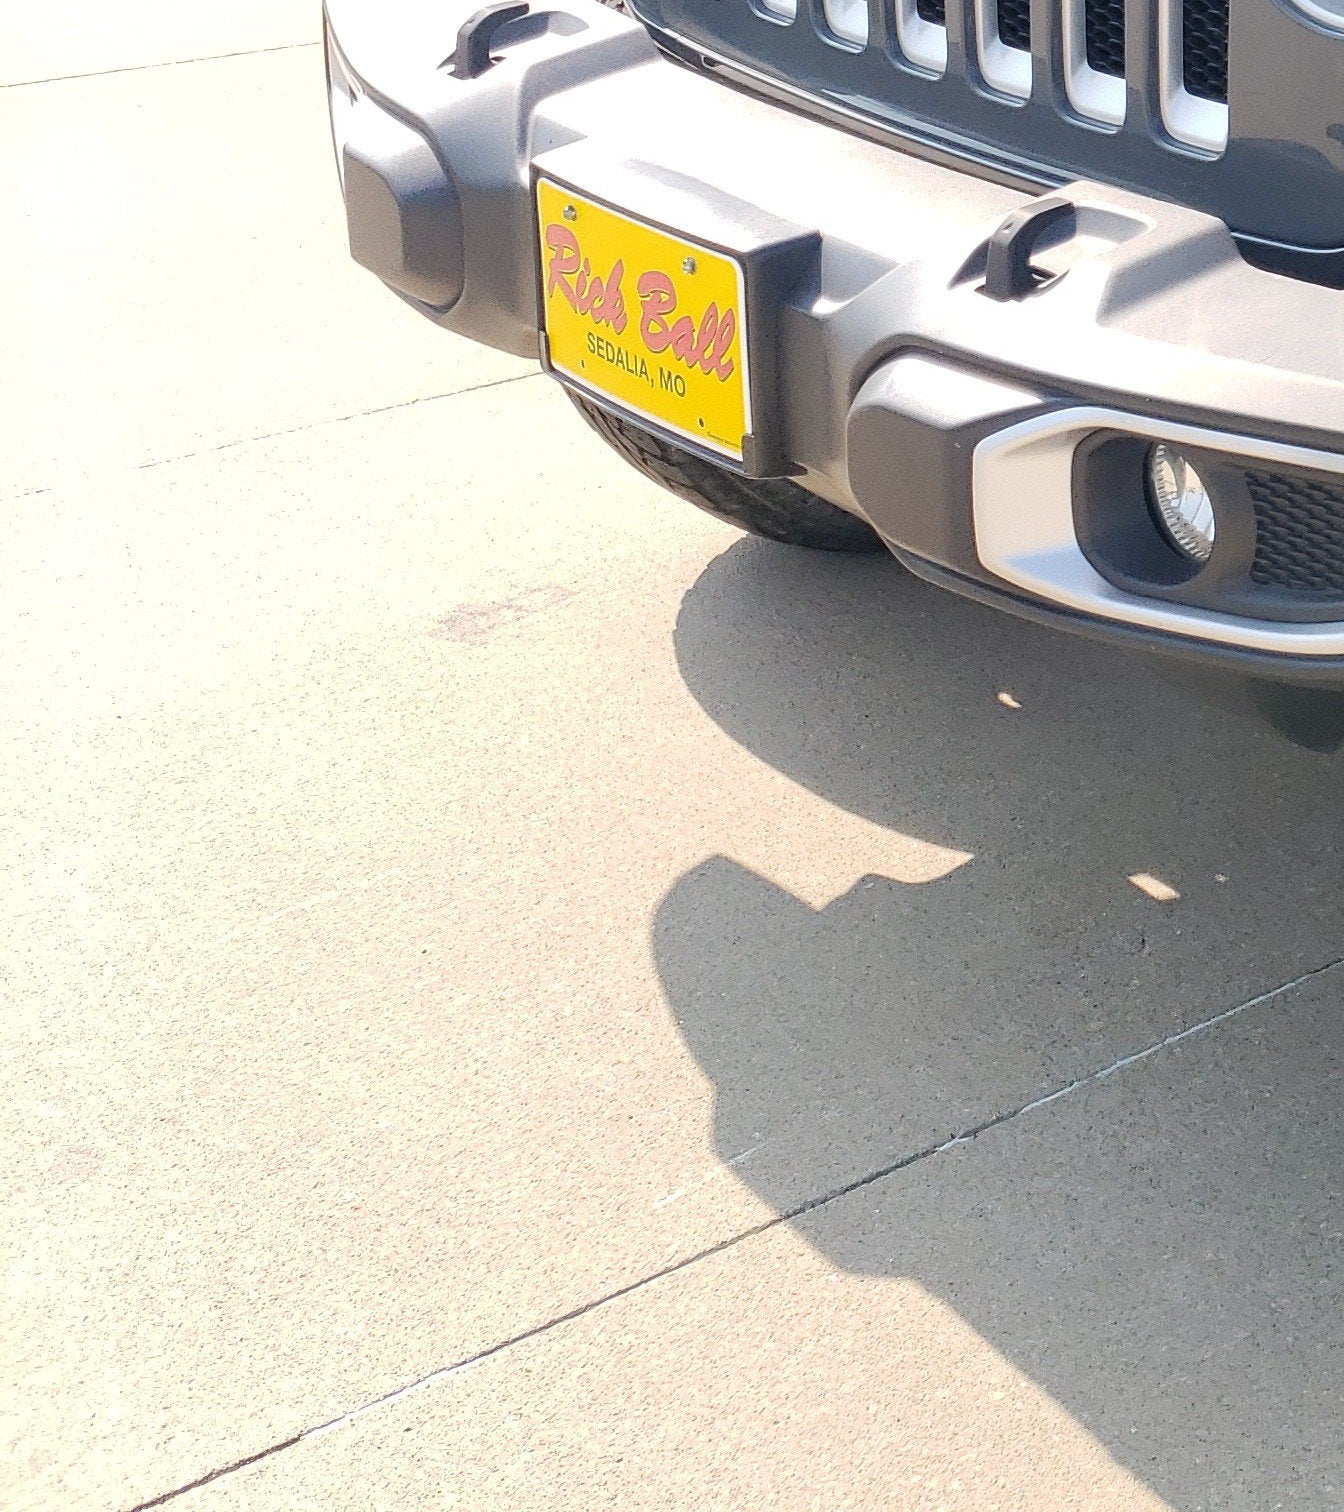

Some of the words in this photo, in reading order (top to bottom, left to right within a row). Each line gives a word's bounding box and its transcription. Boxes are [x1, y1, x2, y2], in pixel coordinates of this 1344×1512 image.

[546, 223, 628, 335] Rick
[636, 270, 736, 382] Ball
[587, 331, 655, 388] SEDALIA,
[659, 366, 687, 398] MO
